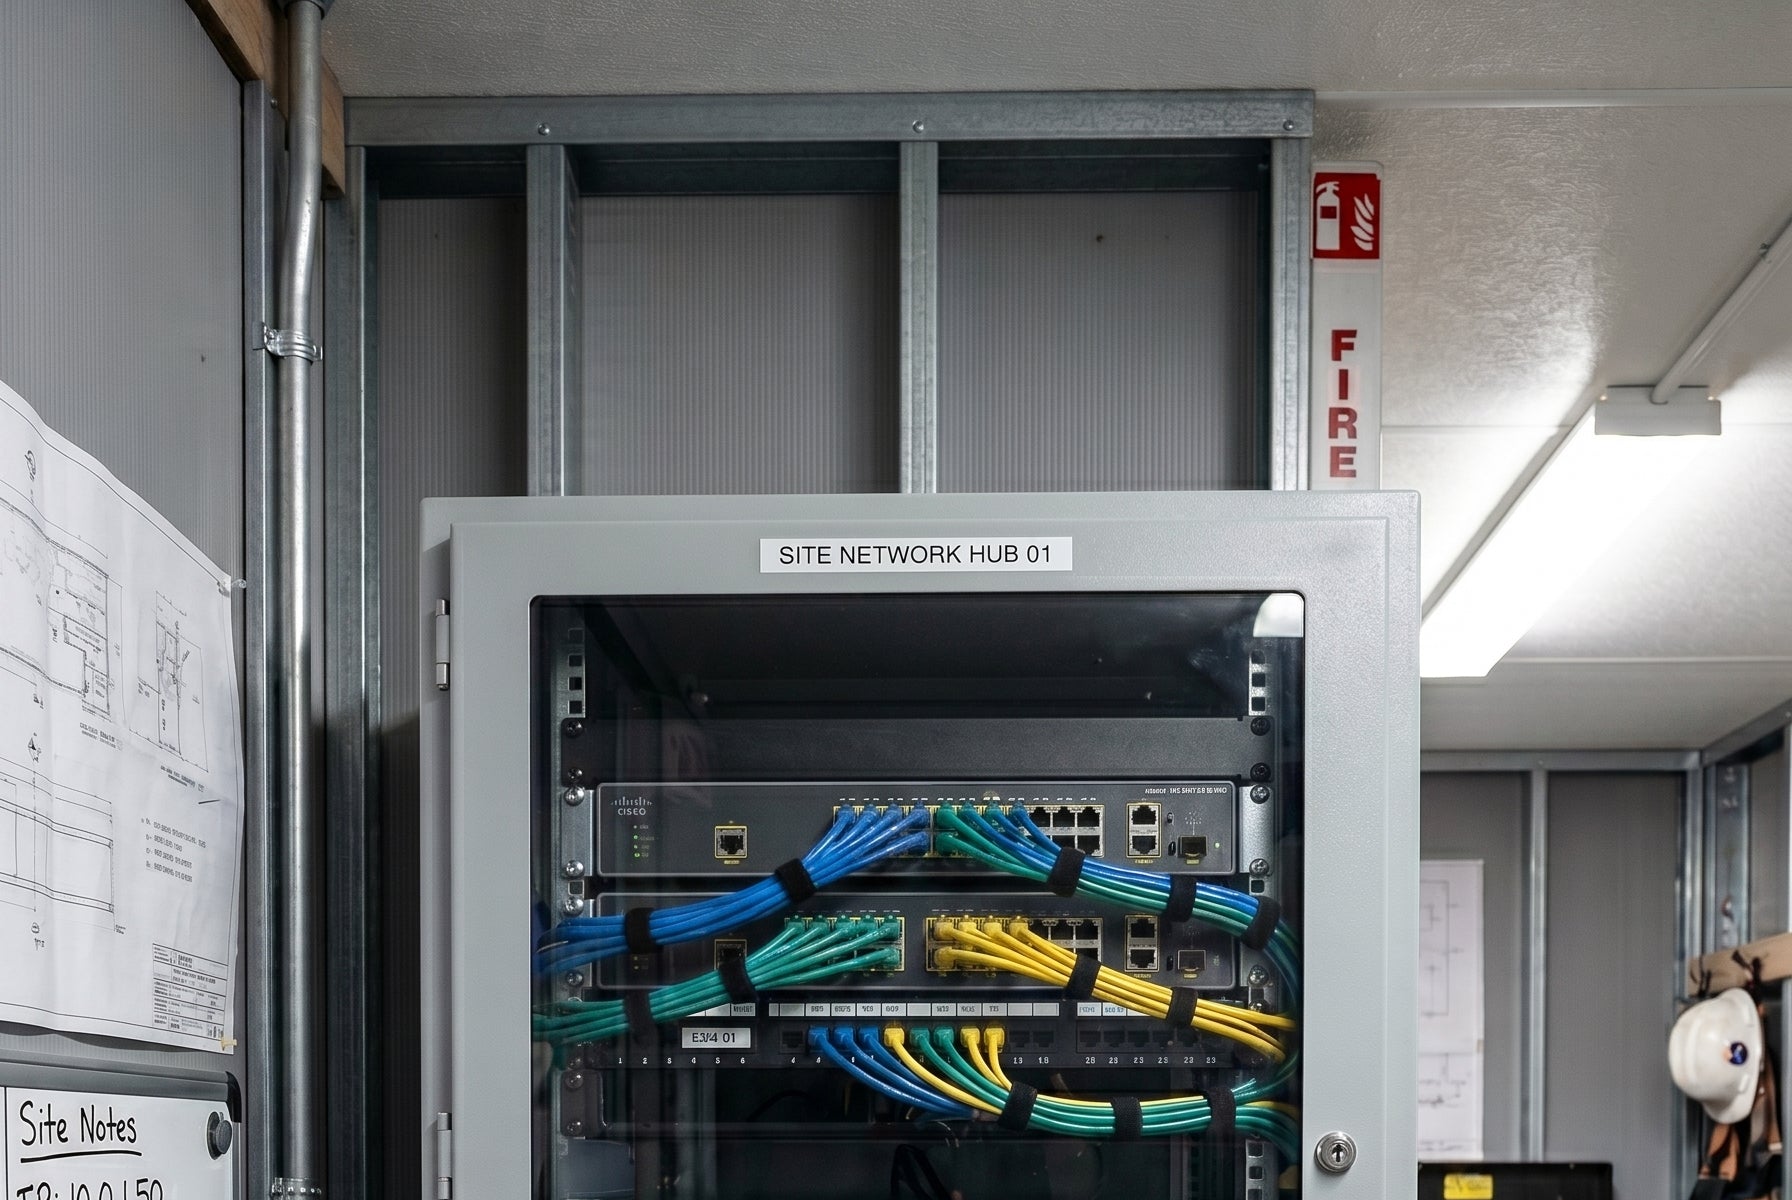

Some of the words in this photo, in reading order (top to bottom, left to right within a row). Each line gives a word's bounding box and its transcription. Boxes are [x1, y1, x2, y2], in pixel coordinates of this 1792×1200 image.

[1328, 329, 1358, 478] FIRE
[779, 546, 832, 565] SITE
[840, 545, 962, 564] NETWORK
[970, 545, 1019, 564] HUB
[1026, 545, 1051, 563] 01
[722, 1033, 736, 1043] 01
[19, 1100, 69, 1147] Site
[80, 1104, 138, 1144] Notes
